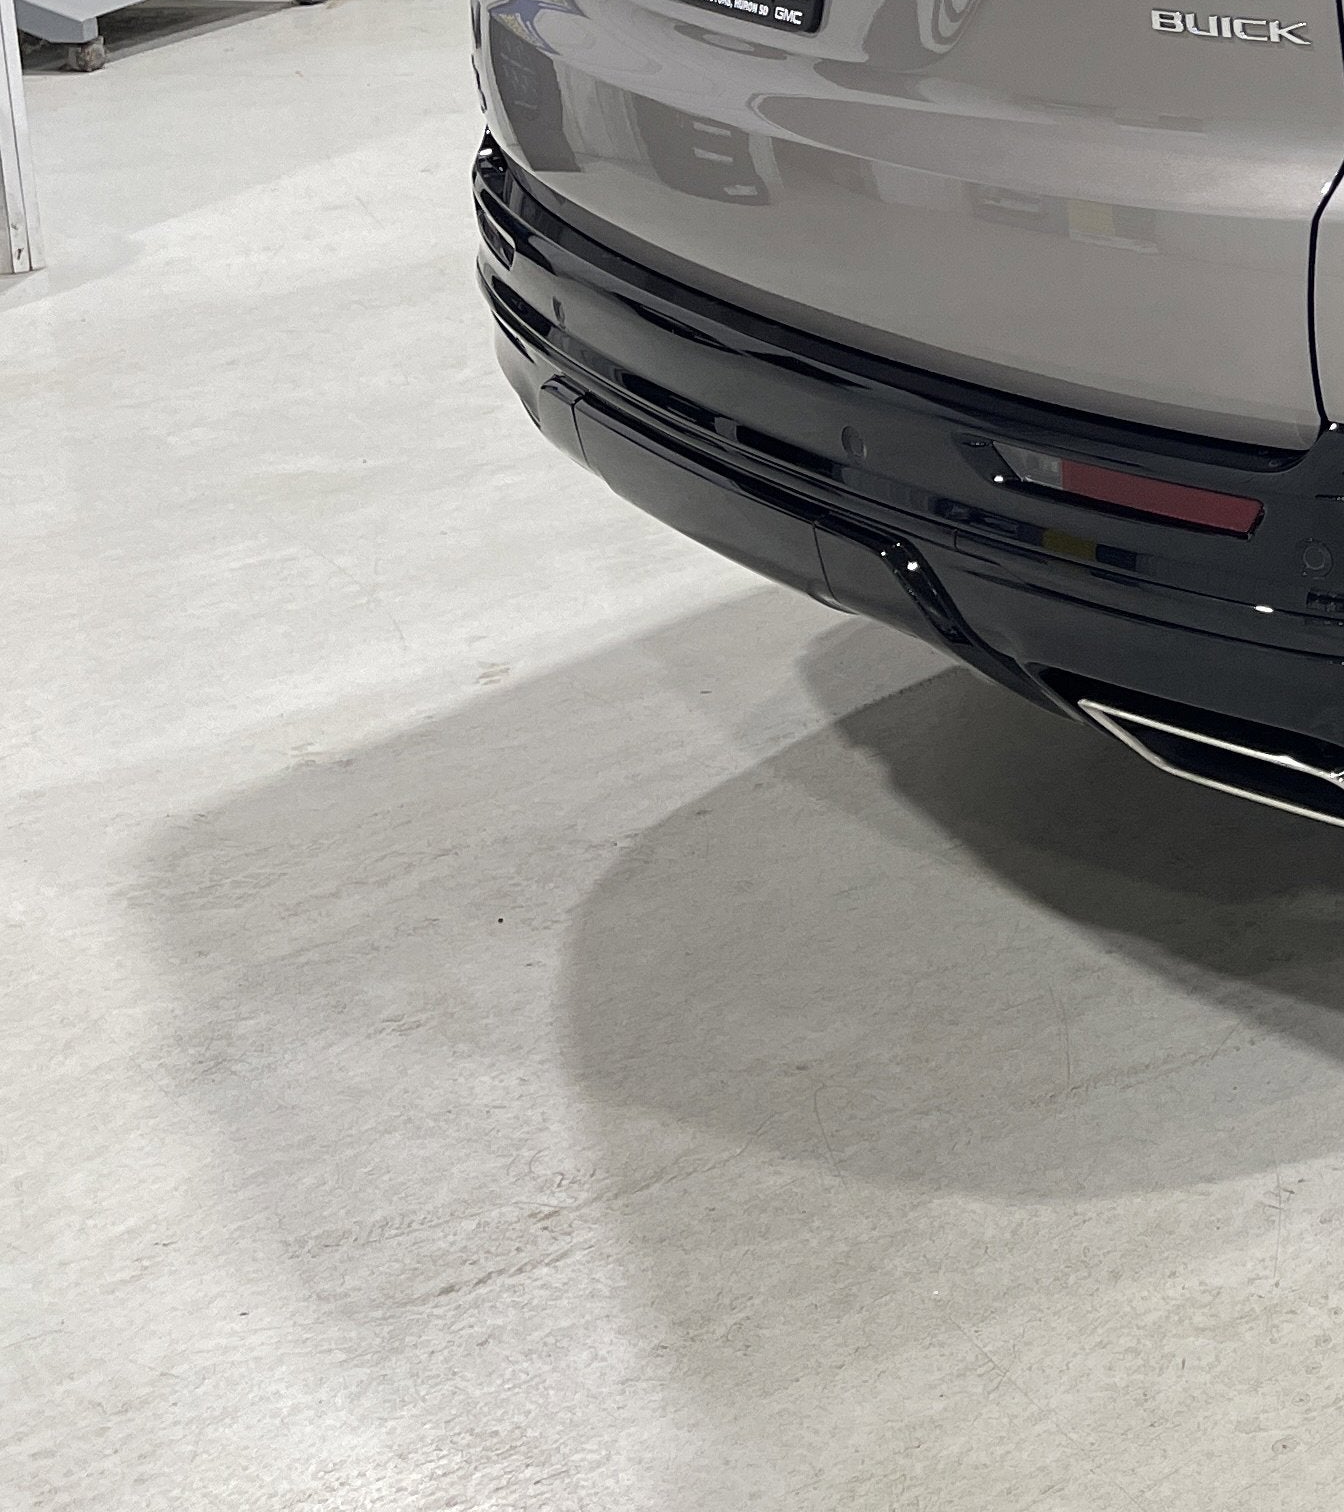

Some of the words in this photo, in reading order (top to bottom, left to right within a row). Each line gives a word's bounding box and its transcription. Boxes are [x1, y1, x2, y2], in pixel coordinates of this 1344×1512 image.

[758, 3, 769, 16] SD
[774, 6, 803, 25] GMC
[1151, 8, 1312, 46] BUICK
